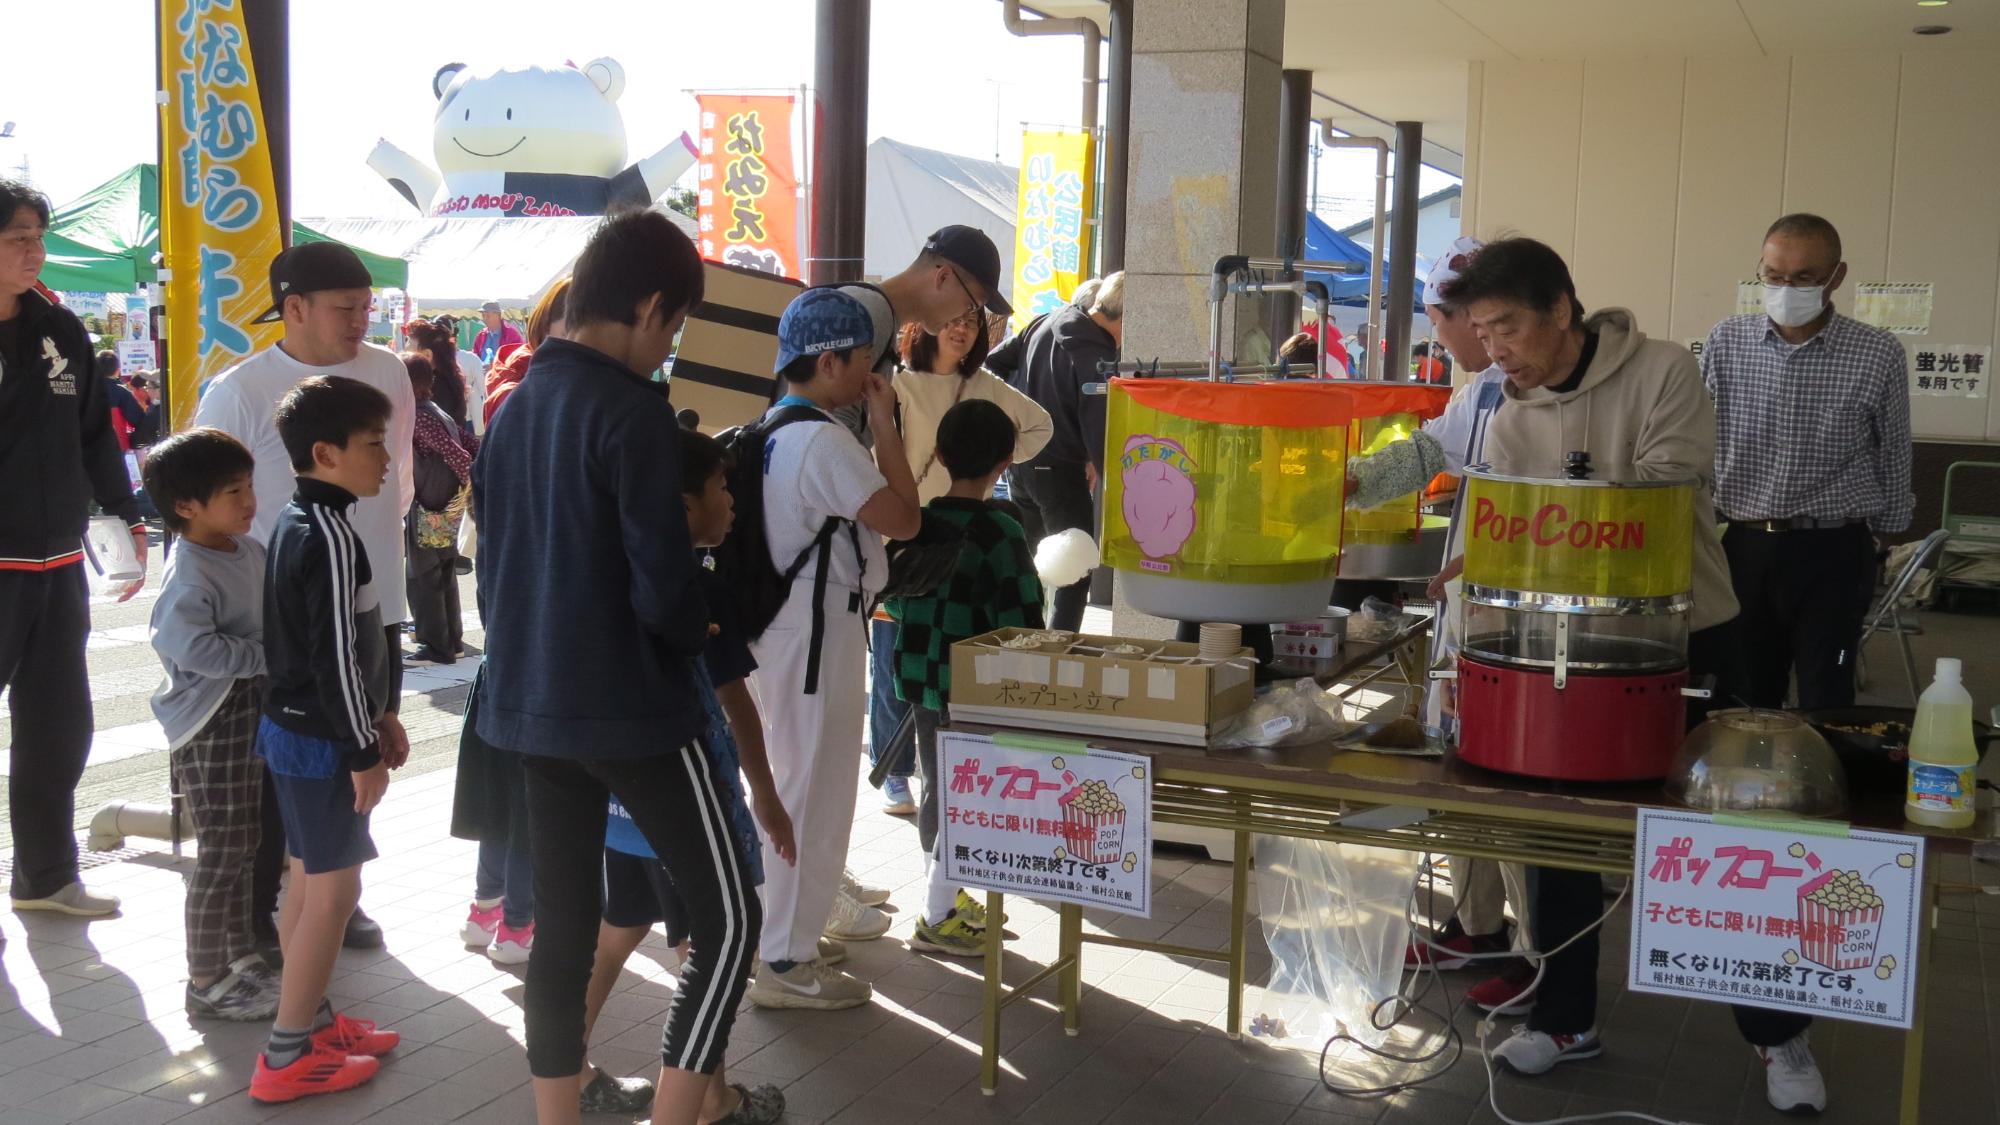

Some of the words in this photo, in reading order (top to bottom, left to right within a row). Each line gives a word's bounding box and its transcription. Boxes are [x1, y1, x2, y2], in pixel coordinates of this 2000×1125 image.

[199, 0, 262, 229] なむら
[1917, 376, 1979, 391] 専用です
[1122, 445, 1190, 472] わたがし
[996, 680, 1126, 712] ポップコーン立て
[949, 757, 1084, 806] ポップコーン
[1097, 840, 1120, 850] CORN
[1100, 829, 1118, 840] POP
[954, 844, 1116, 884] 無くなり次第終了です。
[1648, 836, 1835, 898] ポップコーン
[1645, 902, 1848, 945] 子どもに限り無料配布
[1846, 928, 1870, 941] POP
[1841, 941, 1874, 953] CORN
[1648, 948, 1864, 995] 無くなり次第終了です。
